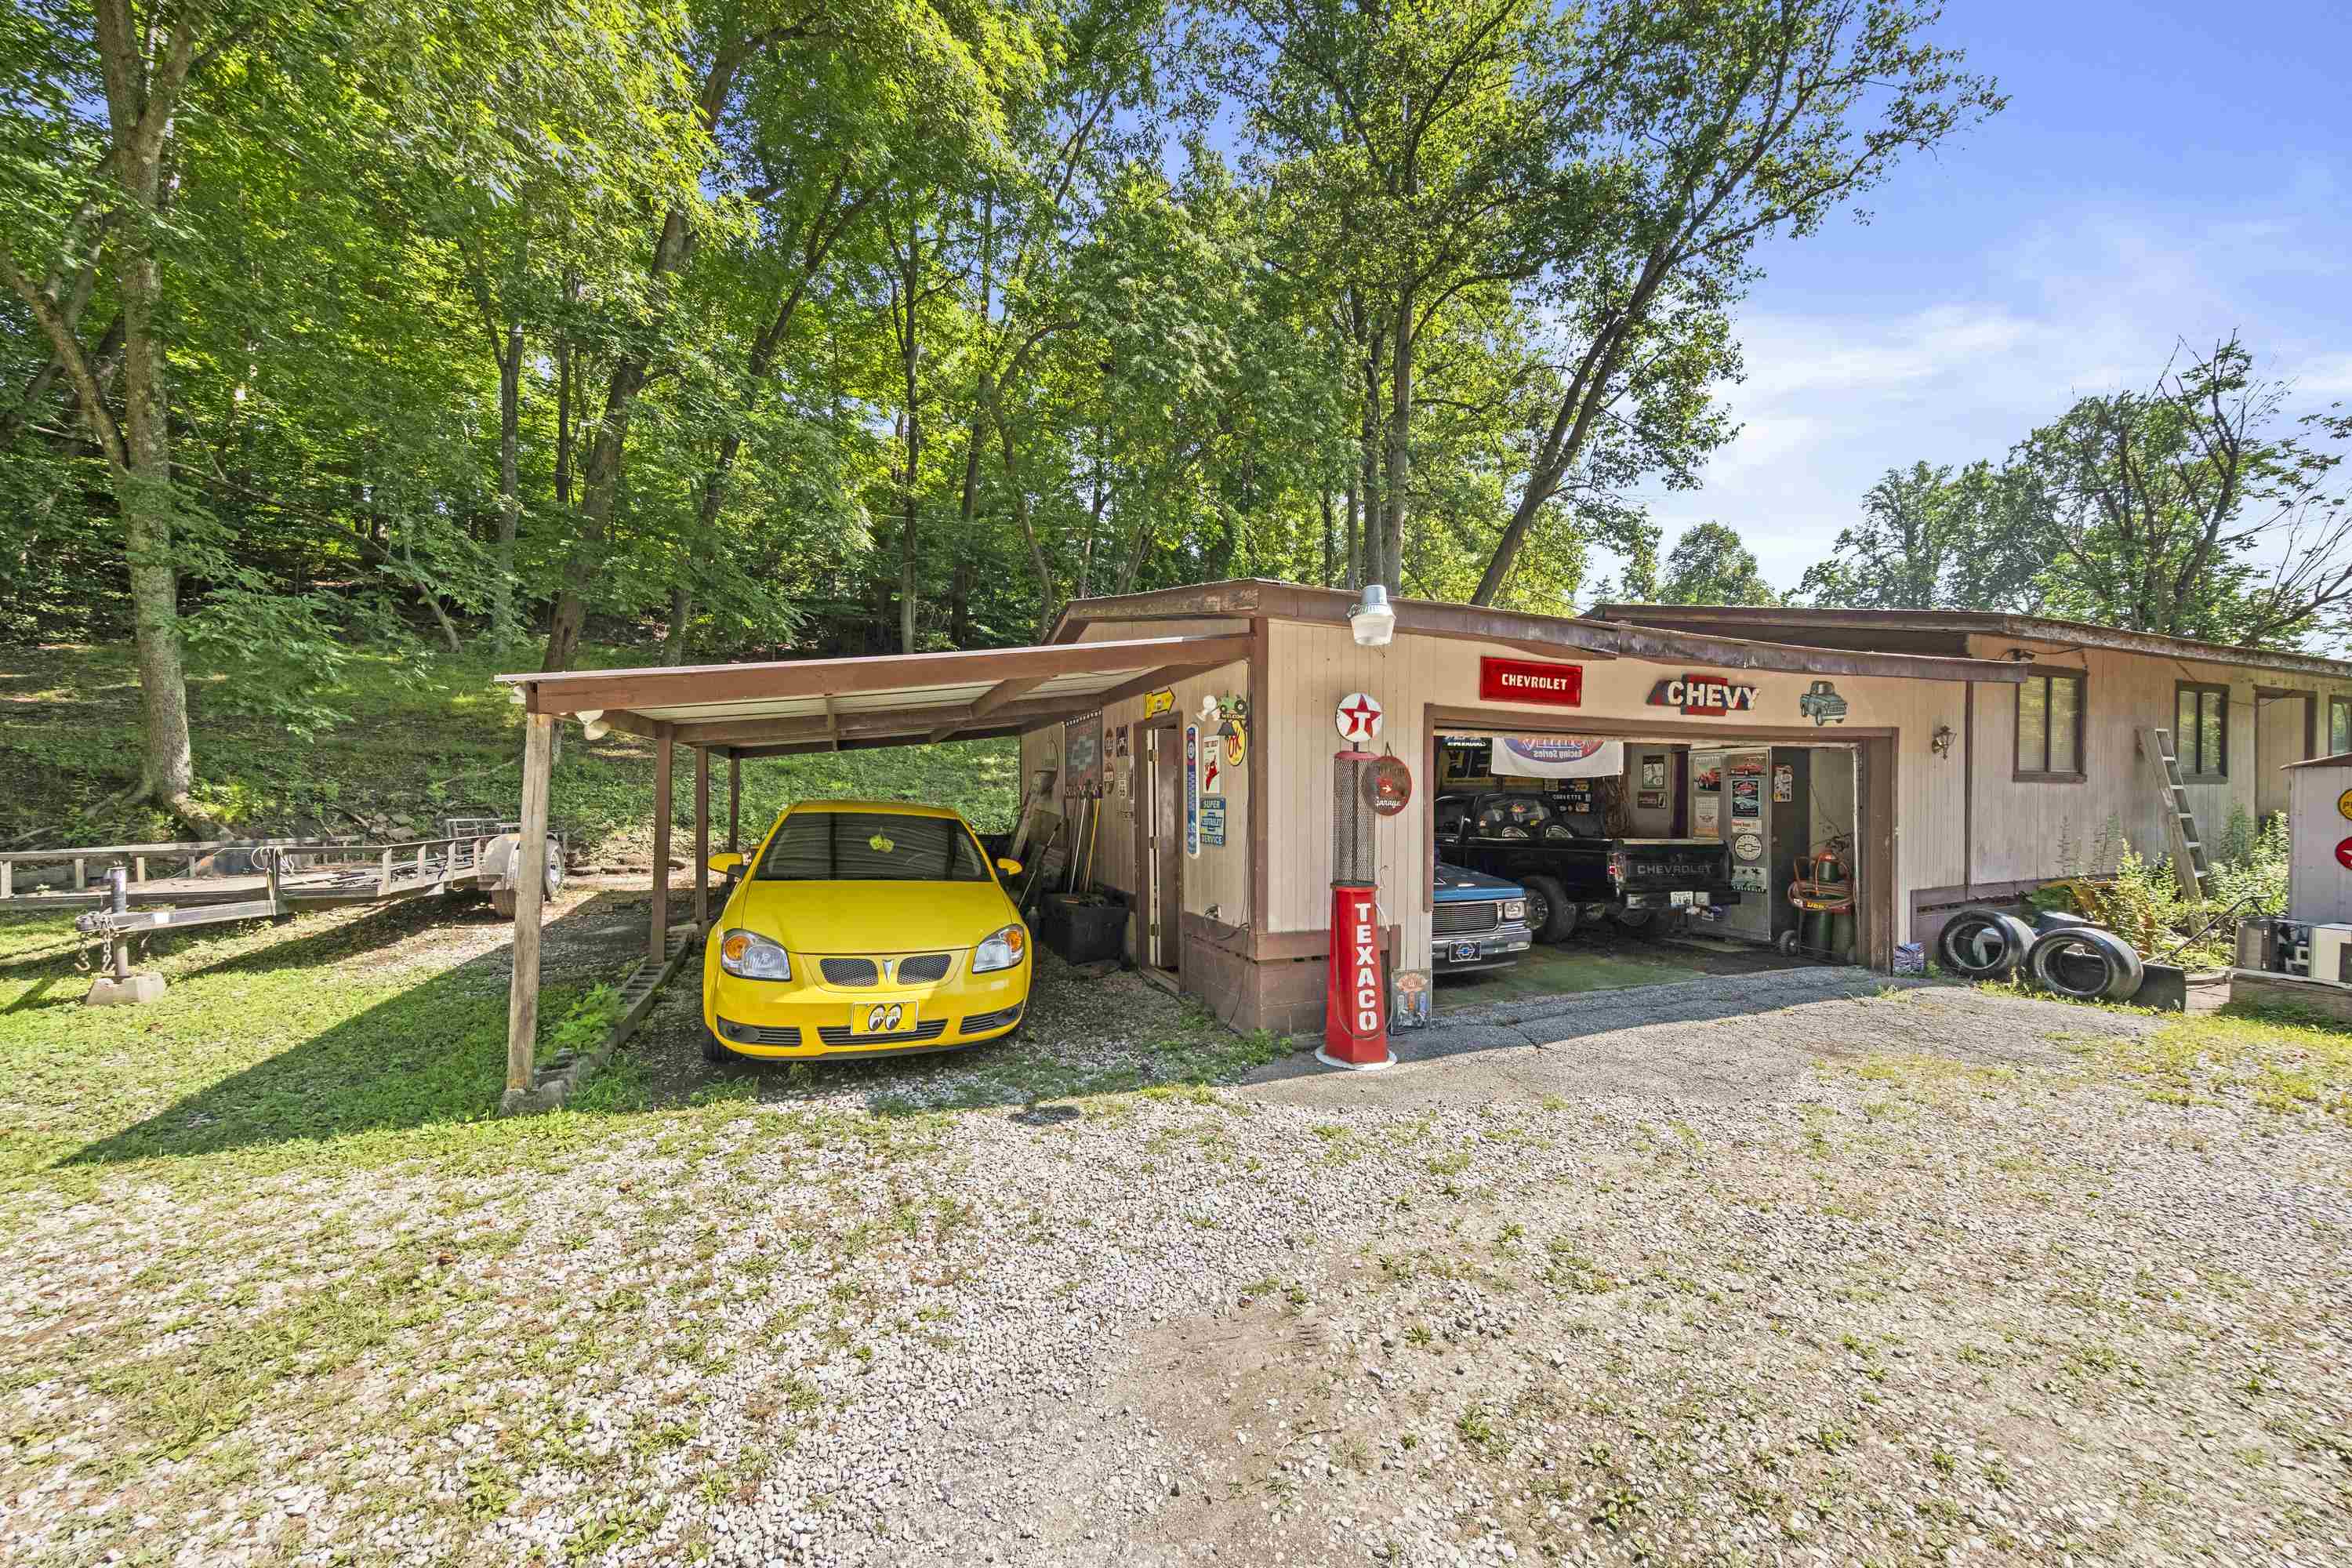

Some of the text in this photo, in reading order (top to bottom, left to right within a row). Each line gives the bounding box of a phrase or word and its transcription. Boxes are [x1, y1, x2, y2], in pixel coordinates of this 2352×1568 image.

[1502, 673, 1568, 691] CHEVROLET
[1668, 681, 1762, 710] CHEVY
[1353, 711, 1370, 731] T
[1229, 728, 1242, 759] OK
[1203, 800, 1220, 809] SUPER
[1637, 865, 1712, 875] CHEVROLET
[1355, 903, 1377, 1031] TEXACO
